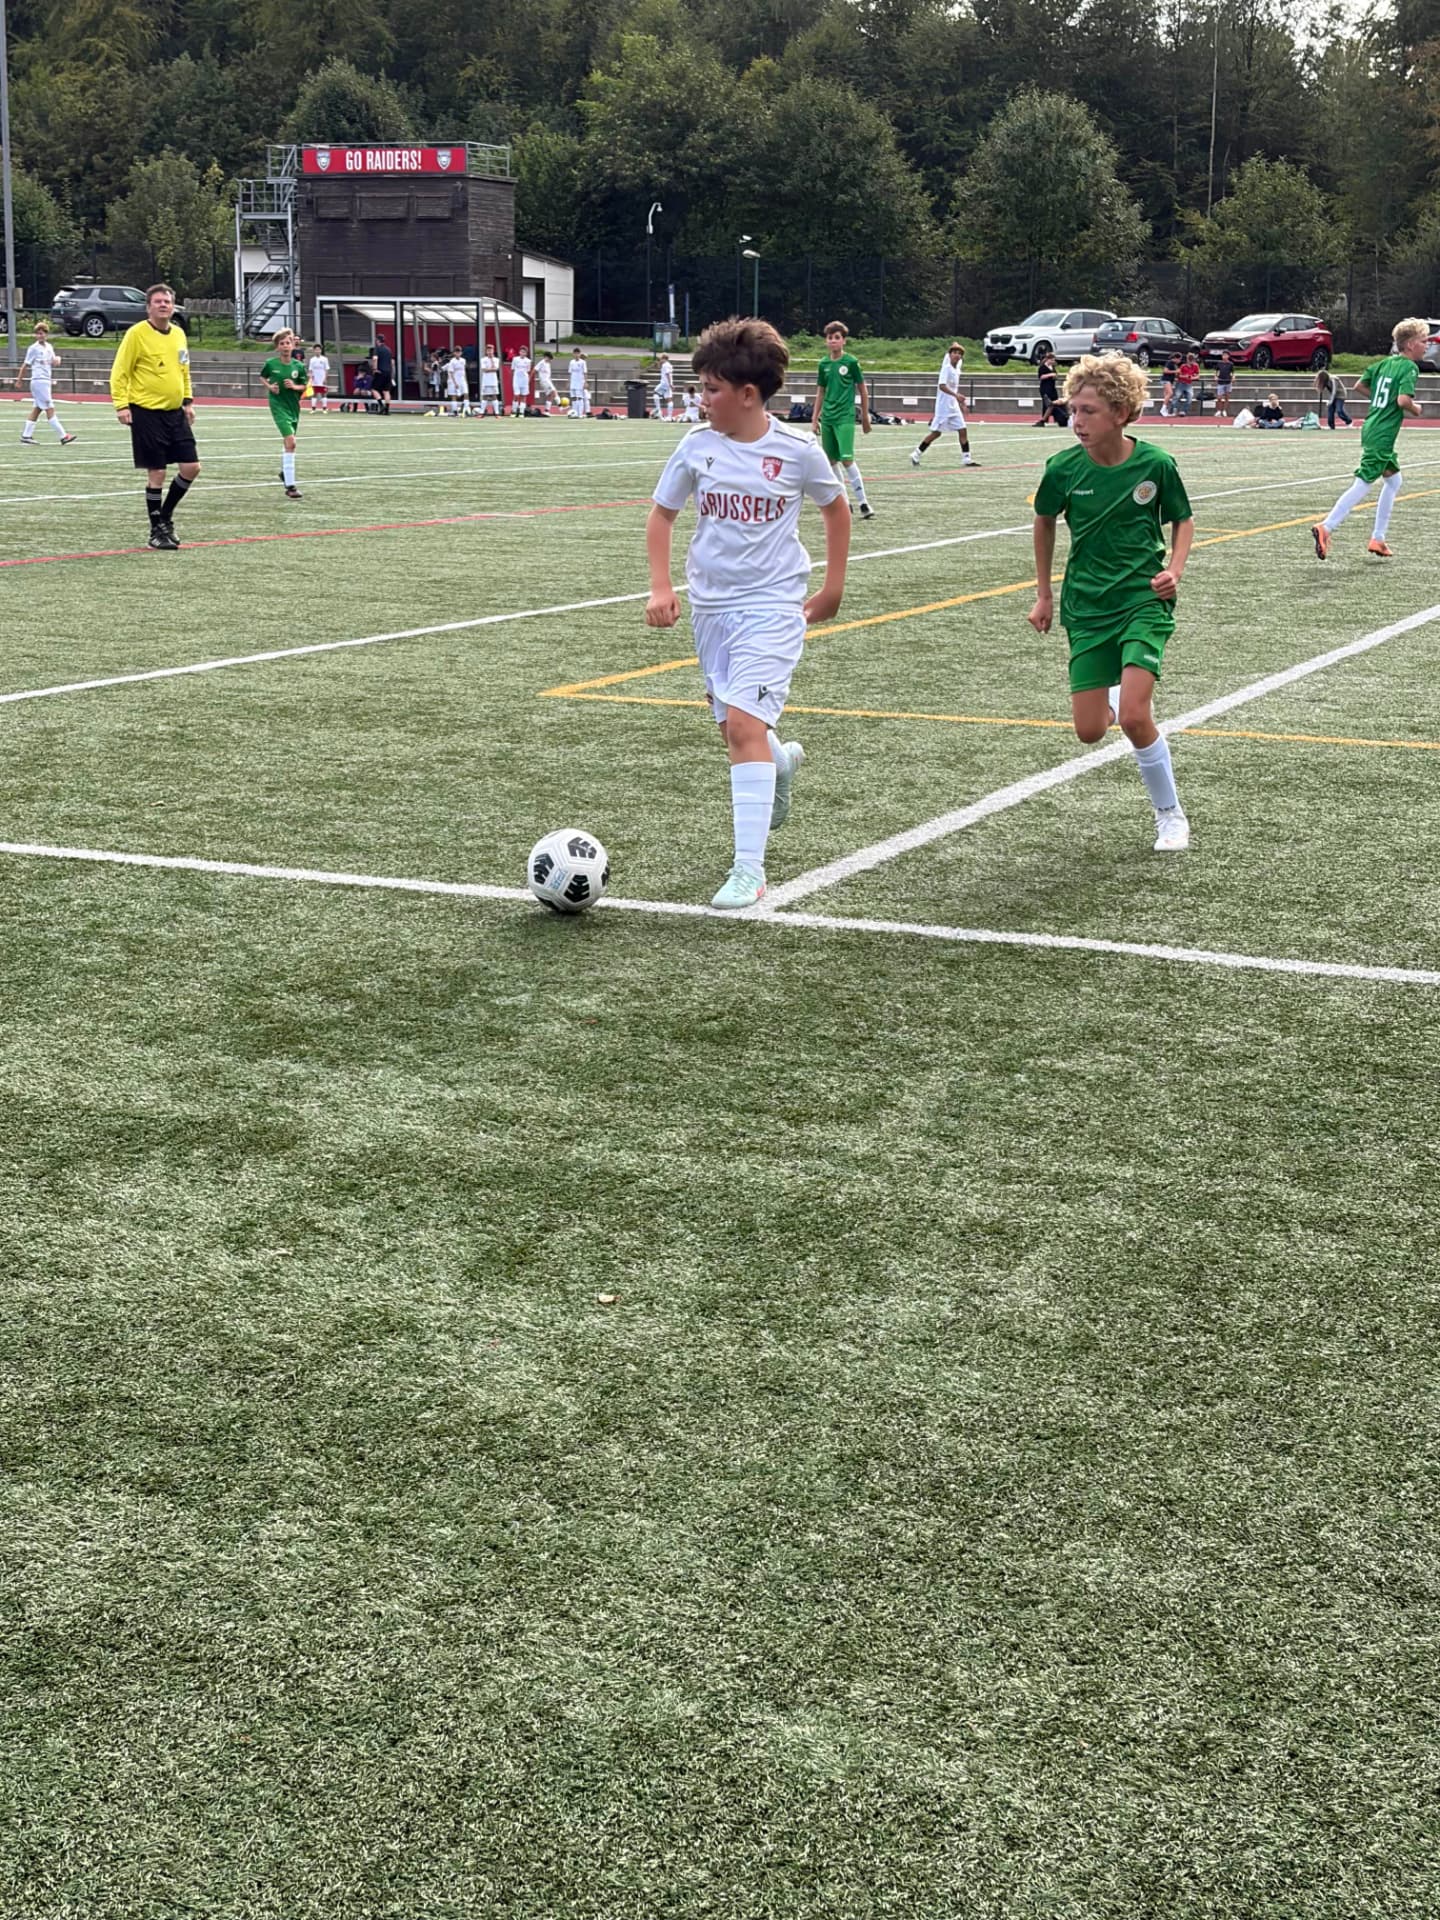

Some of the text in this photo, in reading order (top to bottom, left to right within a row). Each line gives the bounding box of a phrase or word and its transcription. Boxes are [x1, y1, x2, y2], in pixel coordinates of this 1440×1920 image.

[345, 150, 422, 170] GO RAIDERS!
[1372, 375, 1392, 408] 15
[701, 489, 786, 522] BRUSSELS
